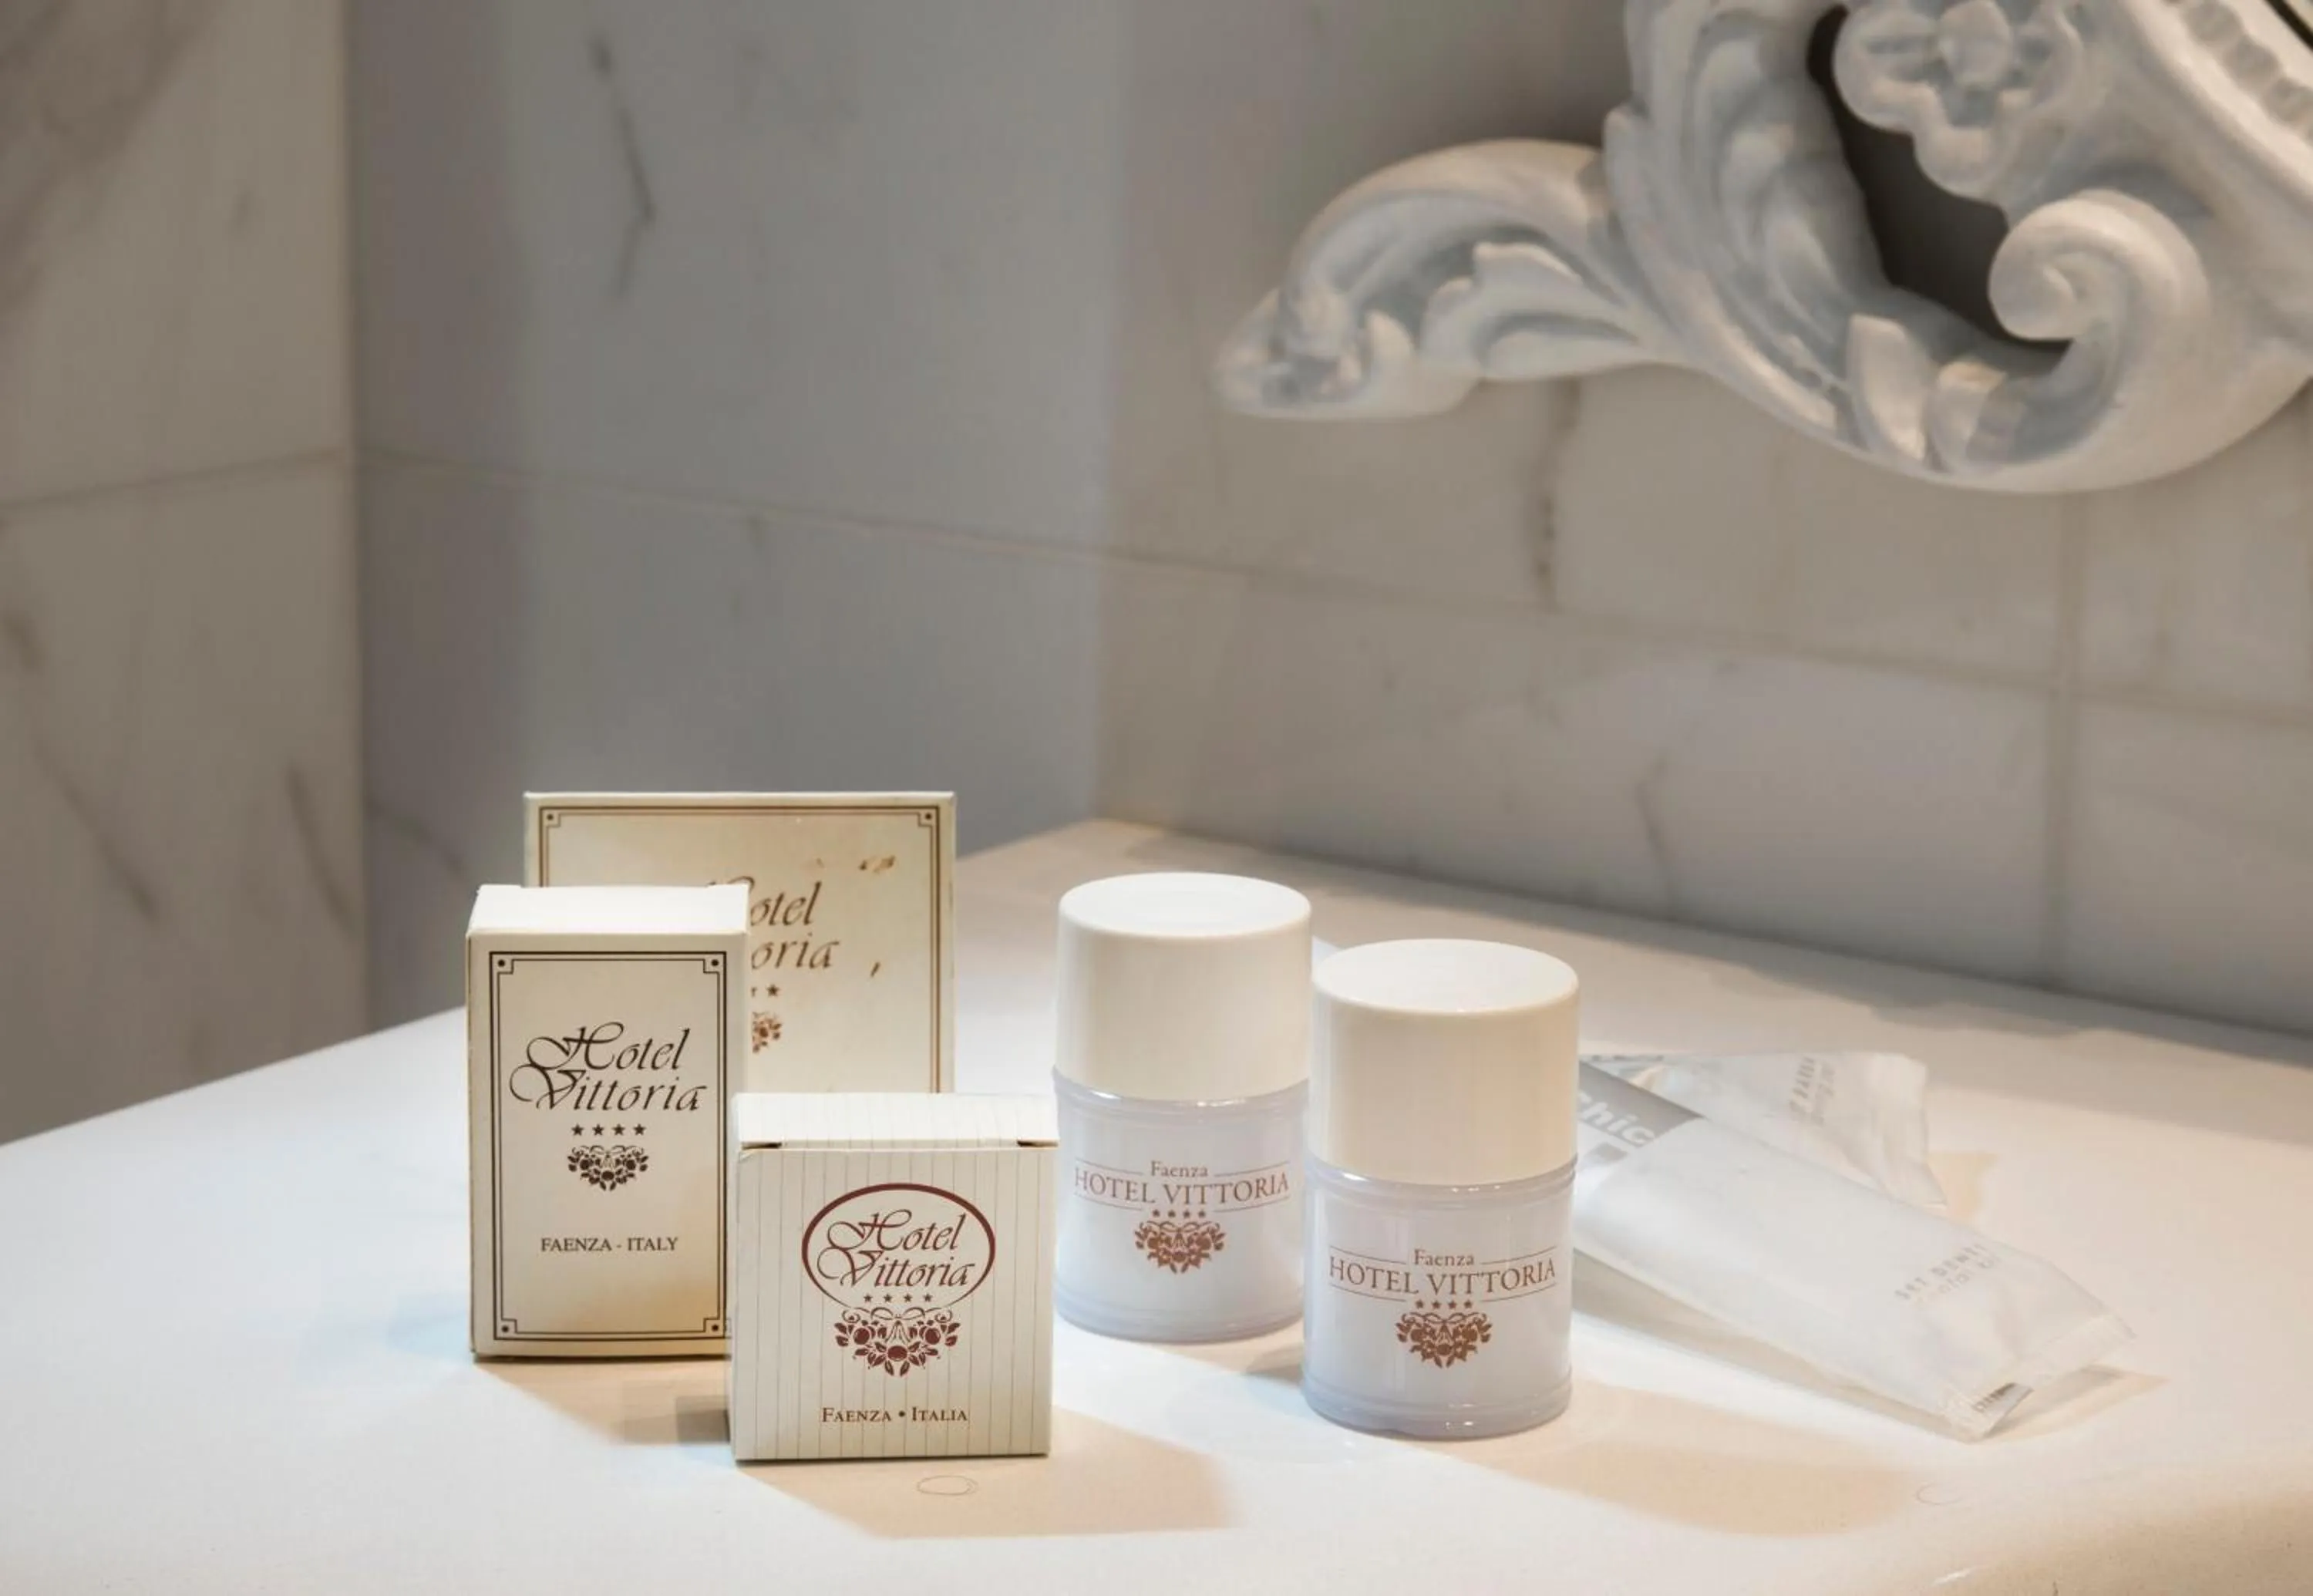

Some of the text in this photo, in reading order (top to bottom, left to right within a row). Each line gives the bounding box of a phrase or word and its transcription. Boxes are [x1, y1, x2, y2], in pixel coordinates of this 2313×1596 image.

[707, 875, 823, 927] otel
[750, 931, 840, 970] oria
[526, 1022, 691, 1071] Hotel
[509, 1063, 708, 1111] Vittoria
[1074, 1166, 1290, 1206] HOTEL VITTORIA
[1150, 1160, 1209, 1179] Faenza
[540, 1237, 613, 1252] FAENZA
[626, 1237, 679, 1252] ITALY
[827, 1208, 967, 1251] Hotel
[816, 1247, 975, 1288] Vittoria
[1329, 1256, 1556, 1296] HOTEL VITTORIA
[1413, 1248, 1475, 1268] Faenza
